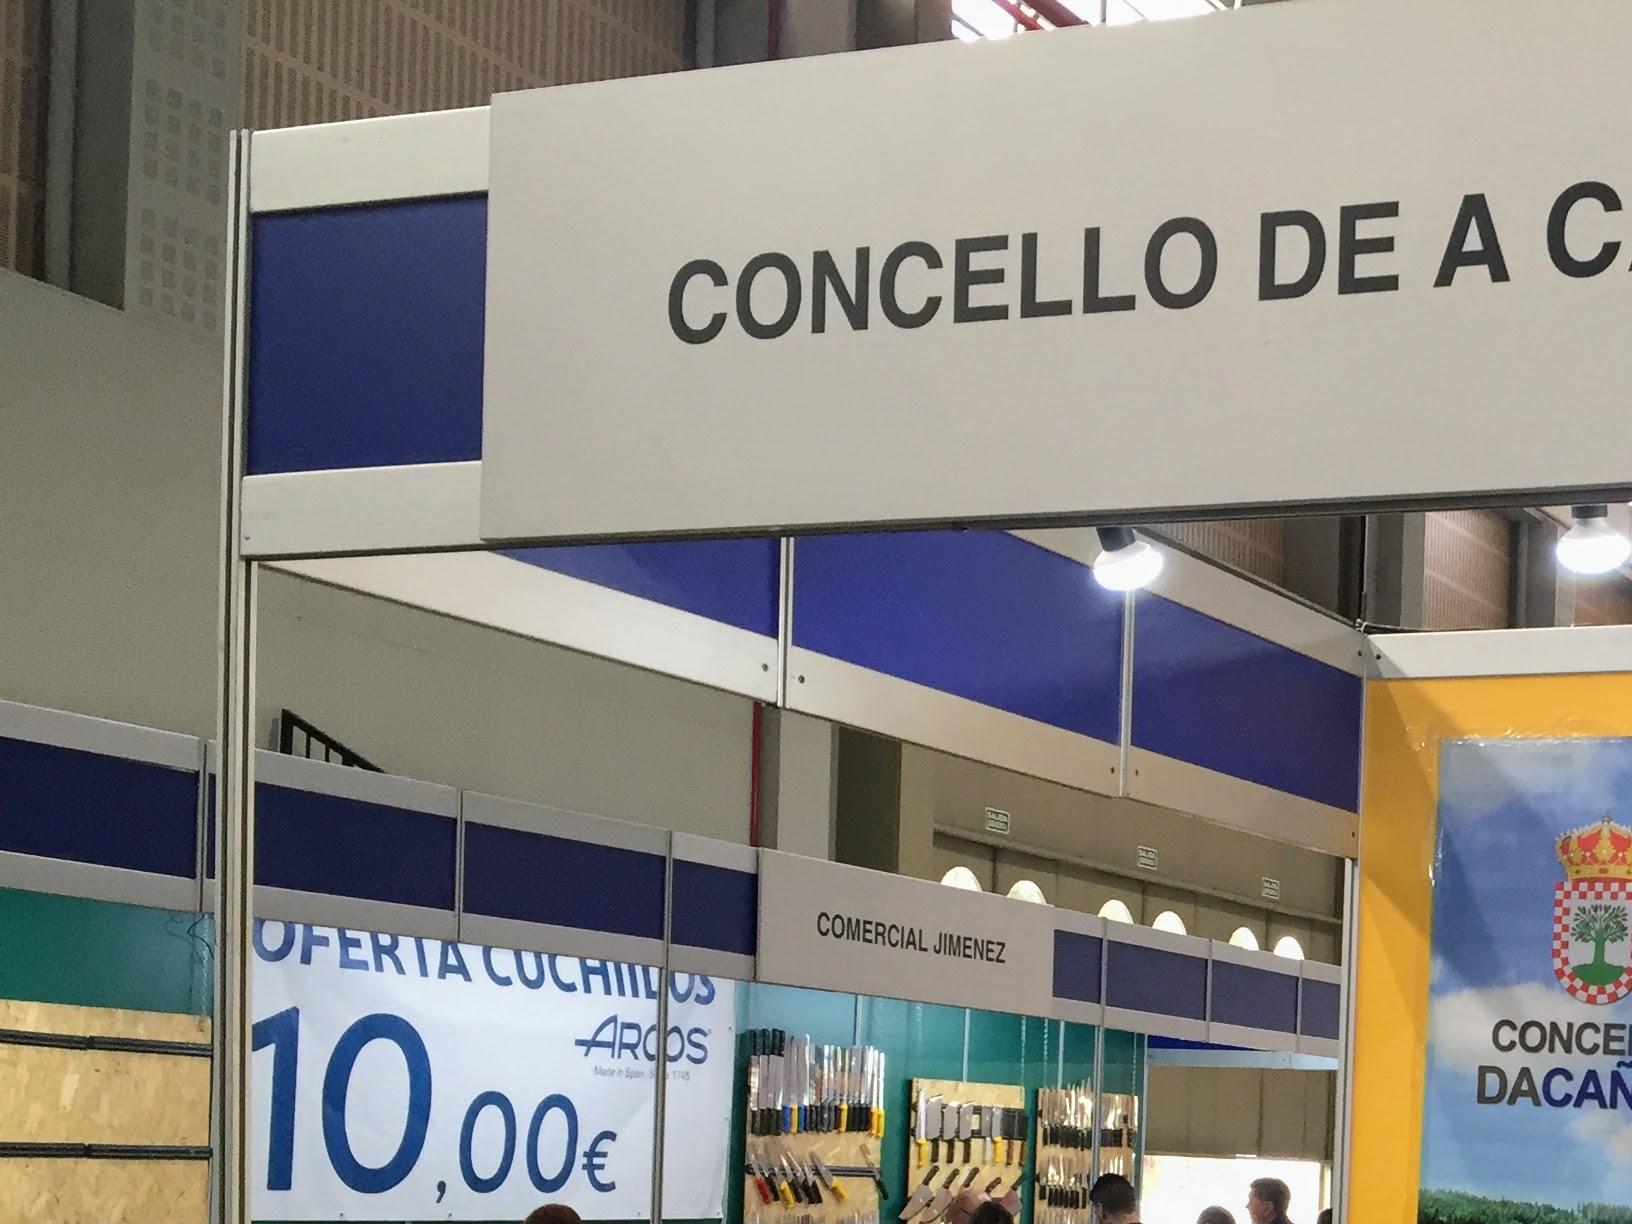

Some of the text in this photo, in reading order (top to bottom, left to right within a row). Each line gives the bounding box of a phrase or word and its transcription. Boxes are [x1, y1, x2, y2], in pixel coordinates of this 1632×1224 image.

[666, 215, 1219, 345] CONCELLO
[1259, 202, 1401, 301] DE
[1433, 193, 1510, 288] A
[817, 912, 1006, 964] COMERCIAL JIMENEZ
[574, 1014, 709, 1065] ARCOS
